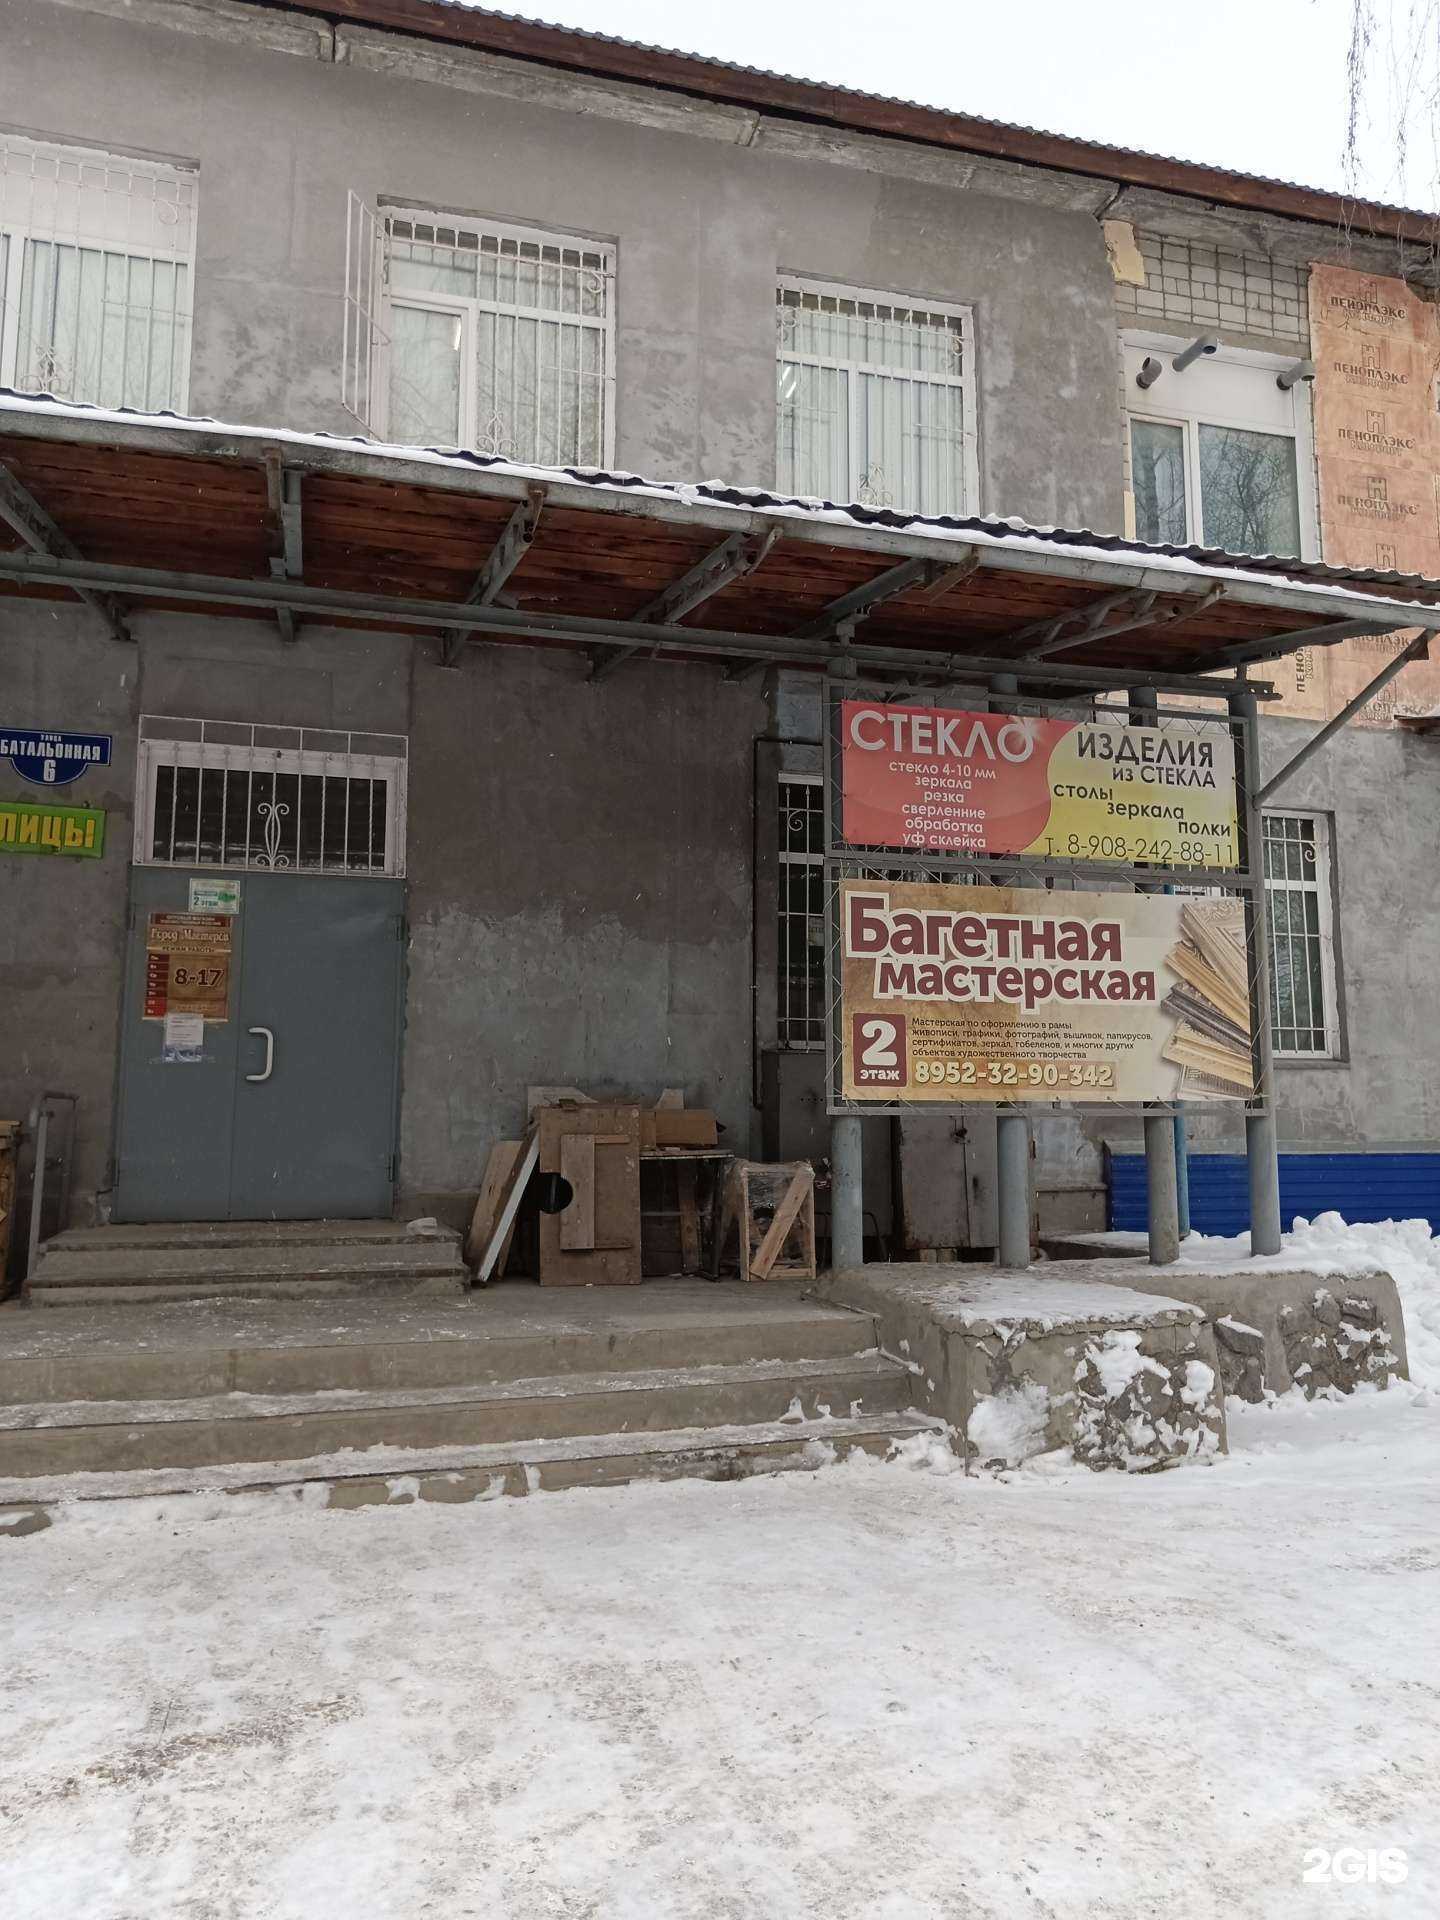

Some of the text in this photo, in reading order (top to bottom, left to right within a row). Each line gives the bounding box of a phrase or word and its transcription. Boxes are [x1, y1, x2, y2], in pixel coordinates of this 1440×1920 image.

[1333, 361, 1409, 385] ПЕНОПЛЭКС
[1337, 428, 1413, 450] ПЕНОПЛЭКС
[1337, 494, 1418, 516] ПЕНОПЛЭКС
[1295, 646, 1306, 693] ПЕНО
[850, 709, 1035, 763] СТЕКЛО
[0, 739, 101, 761] БАТАЛЬОННАЯ
[1077, 731, 1214, 768] ИЗДЕЛИЯ
[43, 759, 57, 782] 6
[889, 761, 997, 779] стекло 4-10 мм
[1112, 768, 1134, 782] из
[914, 776, 972, 790] зеркала
[923, 790, 965, 803] резка
[1053, 784, 1113, 801] столы
[901, 803, 986, 820] сверленние
[1106, 802, 1185, 820] зеркала
[904, 816, 983, 833] обработка
[1178, 821, 1231, 837] полки
[902, 832, 986, 848] уф склейка
[1067, 833, 1233, 863] 8-908-242-88-11
[851, 896, 1123, 962] Багетная
[174, 968, 225, 987] 8-17
[878, 962, 1156, 1010] мастерская
[912, 1018, 965, 1028] Мастерская
[967, 1020, 979, 1028] по
[981, 1020, 1039, 1030] оформлению
[1048, 1022, 1072, 1031] рамы
[860, 1019, 898, 1067] 2
[1105, 1042, 1135, 1051] других
[912, 1048, 1087, 1060] объектов художественного творчества
[859, 1066, 900, 1081] этаж
[915, 1061, 1114, 1087] 8952-32-90-342
